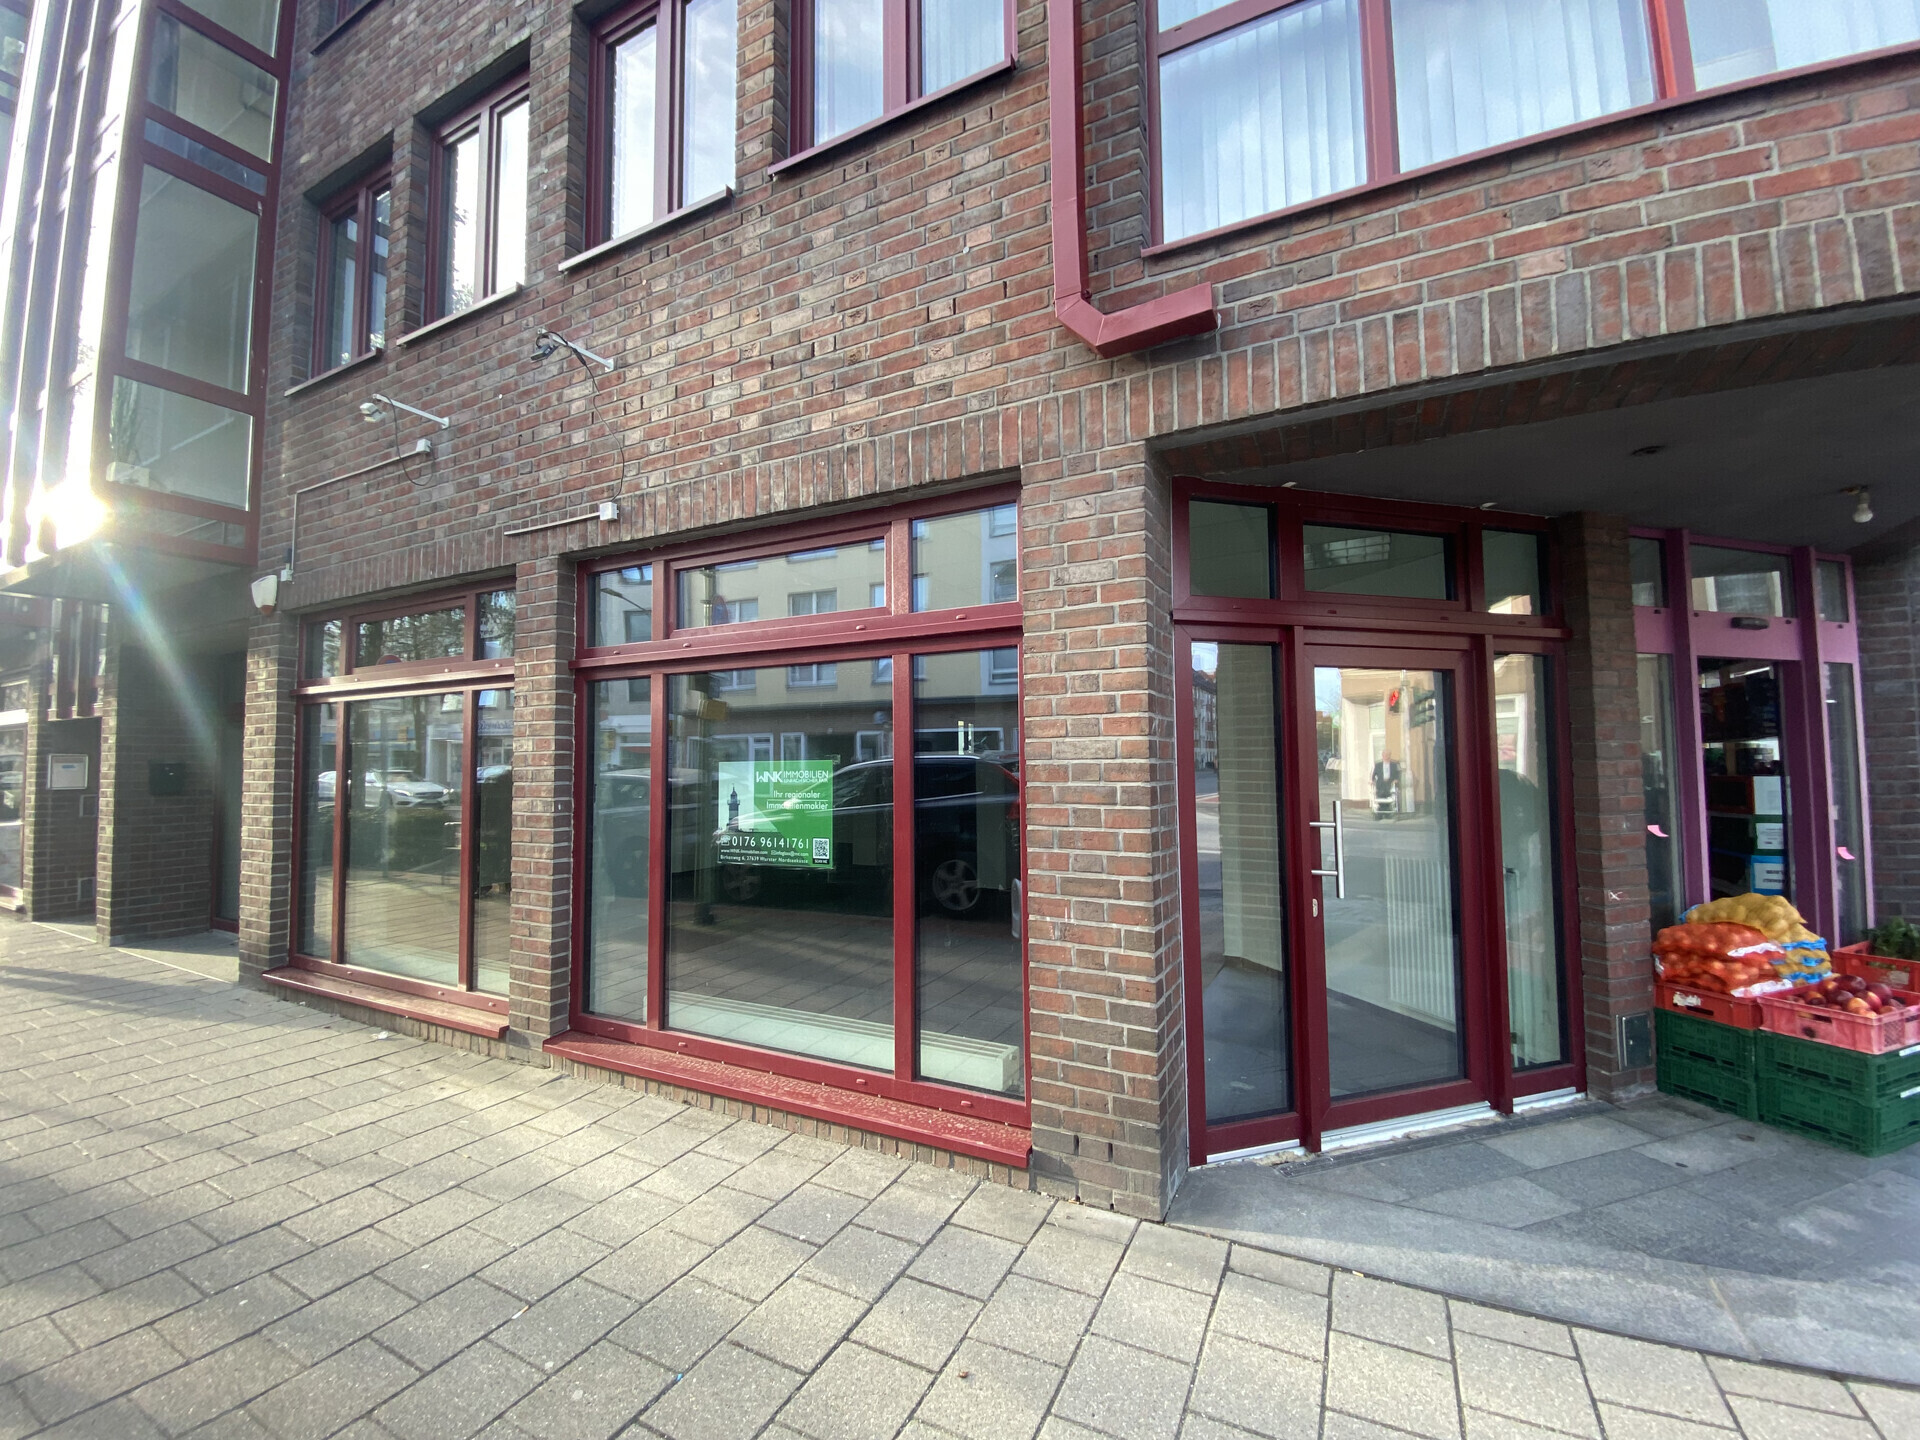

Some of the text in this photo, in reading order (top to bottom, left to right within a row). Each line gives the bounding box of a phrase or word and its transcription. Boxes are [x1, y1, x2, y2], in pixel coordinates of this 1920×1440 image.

[756, 770, 829, 783] WNK IMMOBILIEN
[773, 790, 820, 799] Ihr regionaler
[766, 801, 828, 809] Immolienmakler
[732, 836, 809, 849] 0176 96141761
